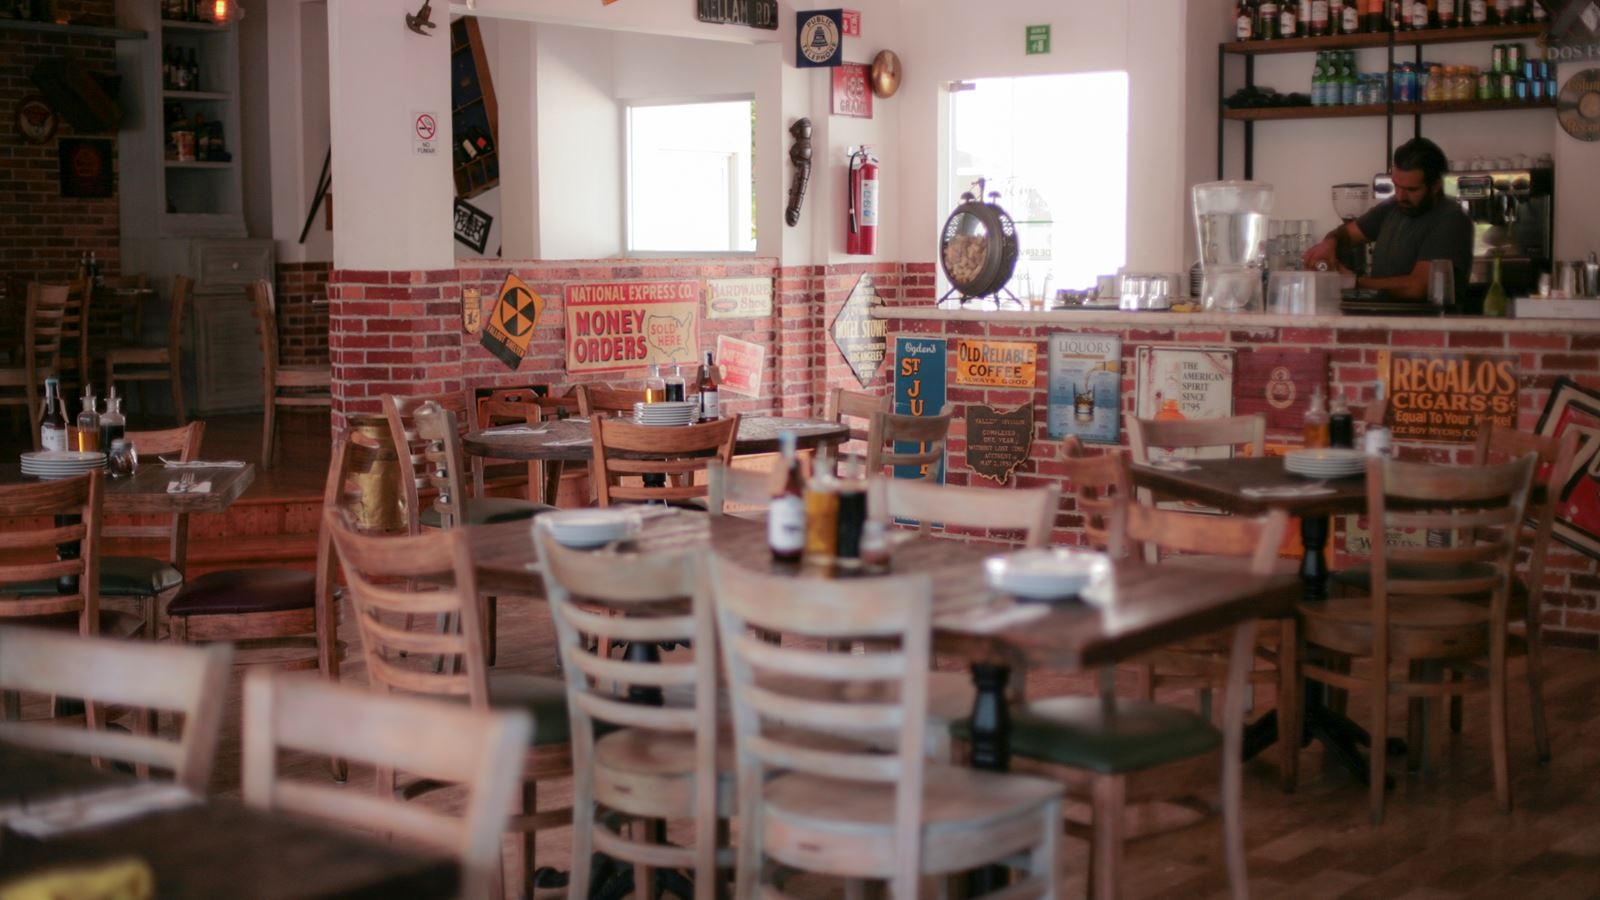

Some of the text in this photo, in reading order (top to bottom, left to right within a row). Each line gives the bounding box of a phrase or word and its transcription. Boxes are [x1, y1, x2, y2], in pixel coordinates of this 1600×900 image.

[806, 16, 834, 28] PUBLIC
[802, 42, 837, 61] TELEPHONE
[1547, 46, 1583, 60] DOS
[570, 283, 694, 303] NATIONAL EXPRESS CO.
[575, 309, 646, 336] MONEY
[650, 323, 677, 335] SOLD
[657, 335, 682, 346] HERE
[573, 336, 648, 363] ORDERS
[905, 342, 936, 356] Ogden's
[959, 342, 1033, 365] OLD RELIABLE
[1059, 341, 1112, 354] LIQUORS
[968, 364, 1023, 379] COFFEE
[1183, 361, 1198, 370] THE
[1001, 378, 1029, 386] GOOD
[1182, 371, 1224, 381] AMERICAN
[1392, 357, 1517, 396] REGALOS
[1182, 382, 1209, 391] SPIRIT
[1182, 393, 1205, 402] SINCE
[1429, 412, 1442, 423] To
[1443, 412, 1472, 425] Your
